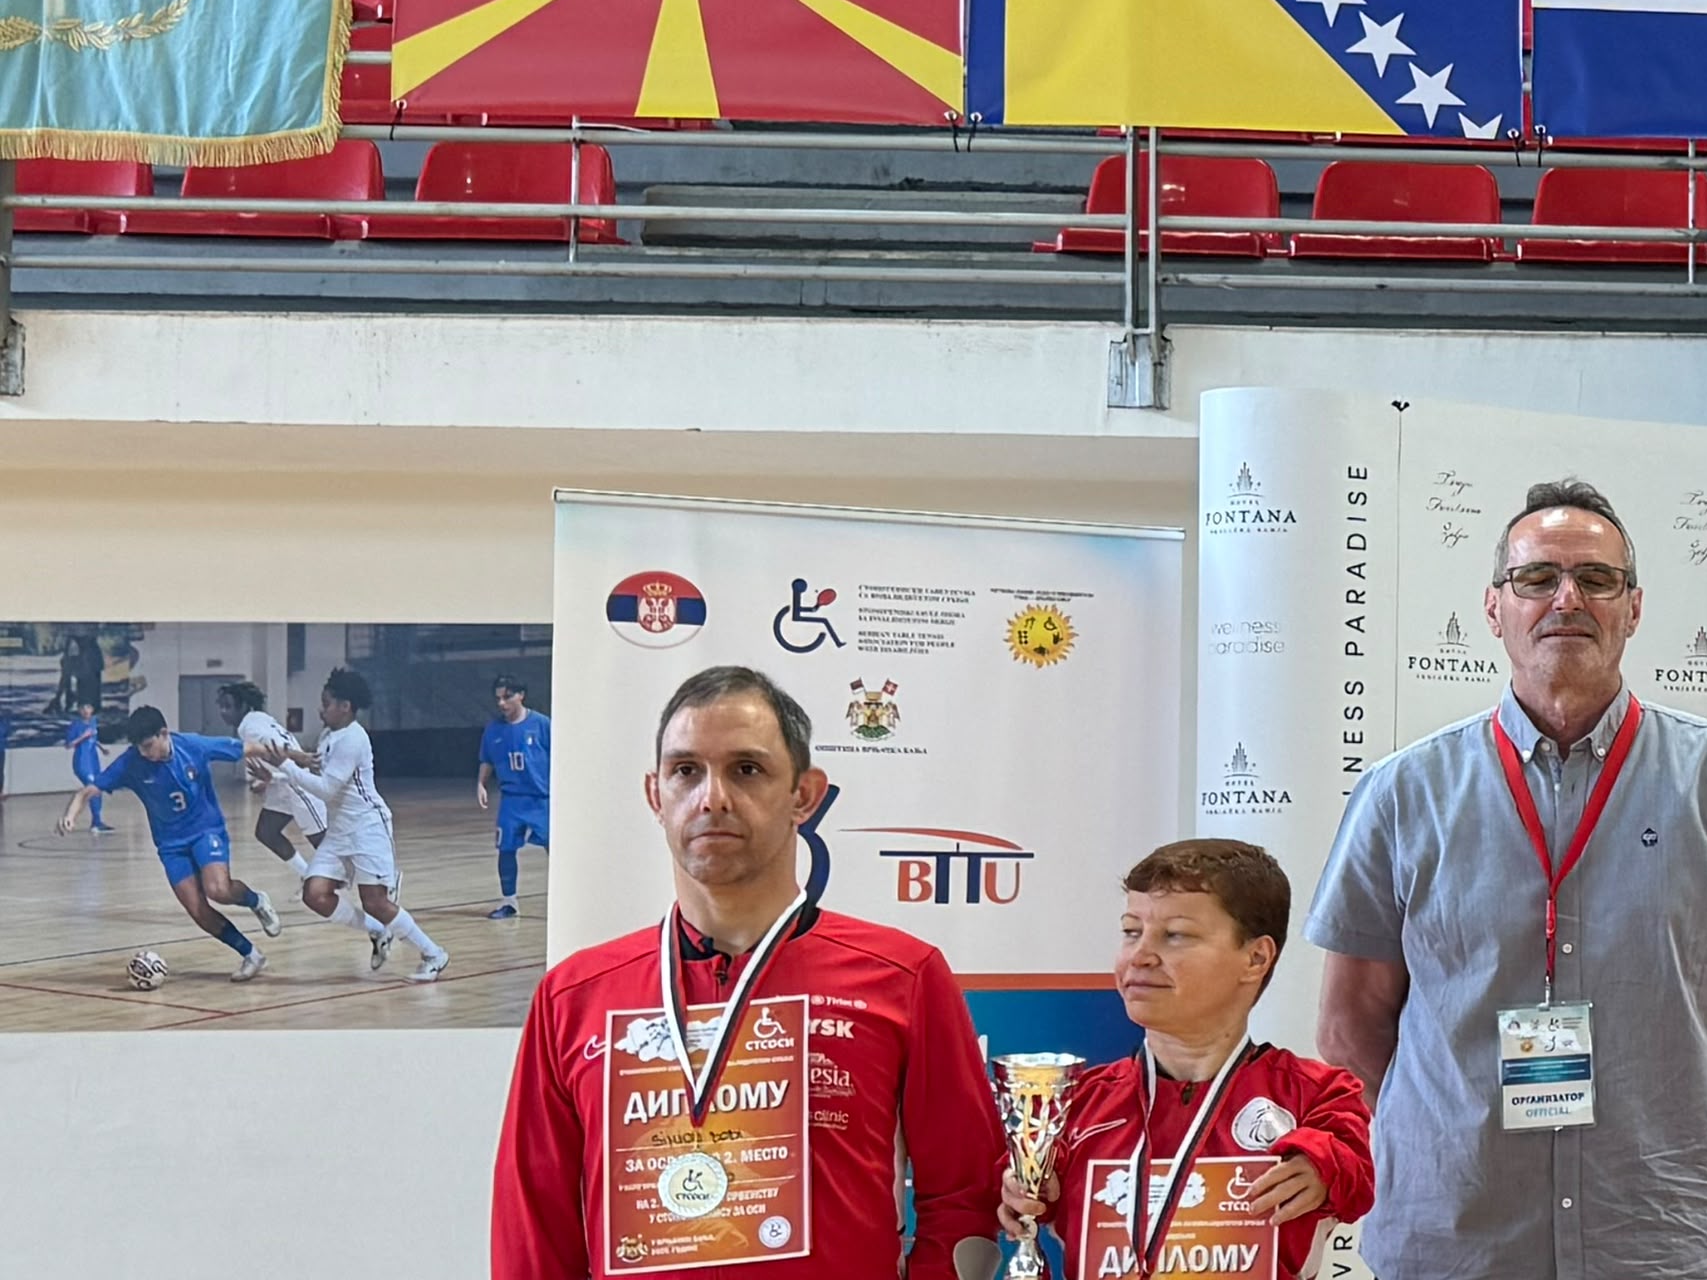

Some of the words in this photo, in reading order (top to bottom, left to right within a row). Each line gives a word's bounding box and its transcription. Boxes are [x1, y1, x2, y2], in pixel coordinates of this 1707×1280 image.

[1345, 466, 1368, 657] PARADISE
[1408, 656, 1499, 675] FONTANA
[508, 751, 525, 772] 10
[169, 792, 188, 813] 3
[740, 1146, 788, 1163] МЕСТО
[1218, 1200, 1251, 1212] СТСО
